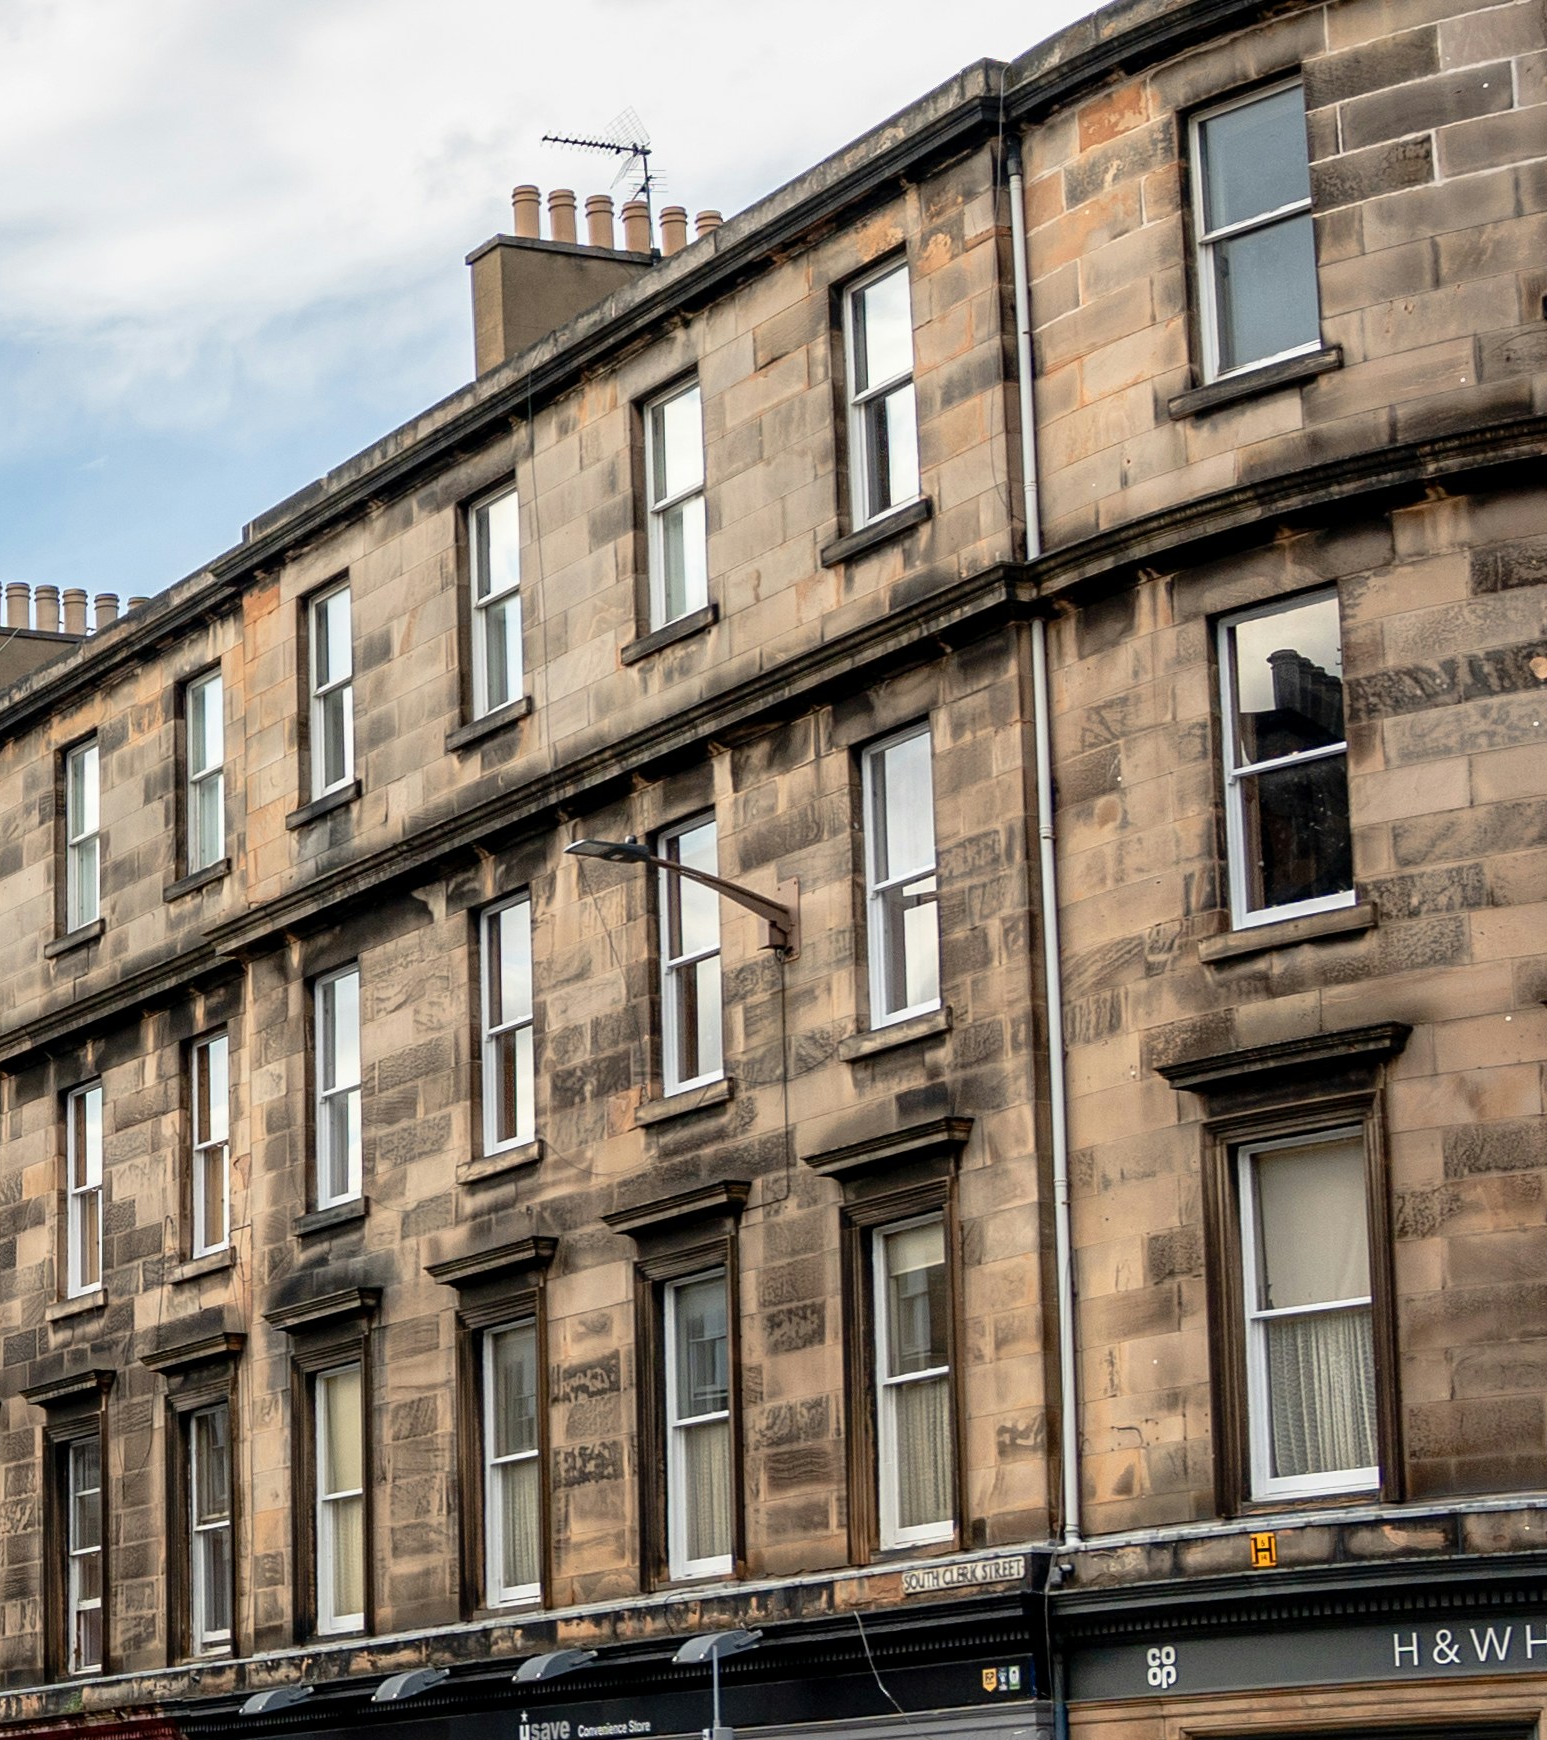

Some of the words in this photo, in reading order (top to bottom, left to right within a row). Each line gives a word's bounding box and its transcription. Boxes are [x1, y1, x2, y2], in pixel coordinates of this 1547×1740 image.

[904, 1567, 939, 1592] SOUTH
[942, 1562, 978, 1587] CLERK
[981, 1558, 1023, 1582] STREET
[1147, 1646, 1176, 1667] co
[1393, 1631, 1419, 1667] H
[1432, 1629, 1462, 1664] &
[1469, 1626, 1513, 1662] W
[1147, 1665, 1177, 1689] op
[578, 1723, 627, 1739] Convenience
[628, 1719, 651, 1734] Store
